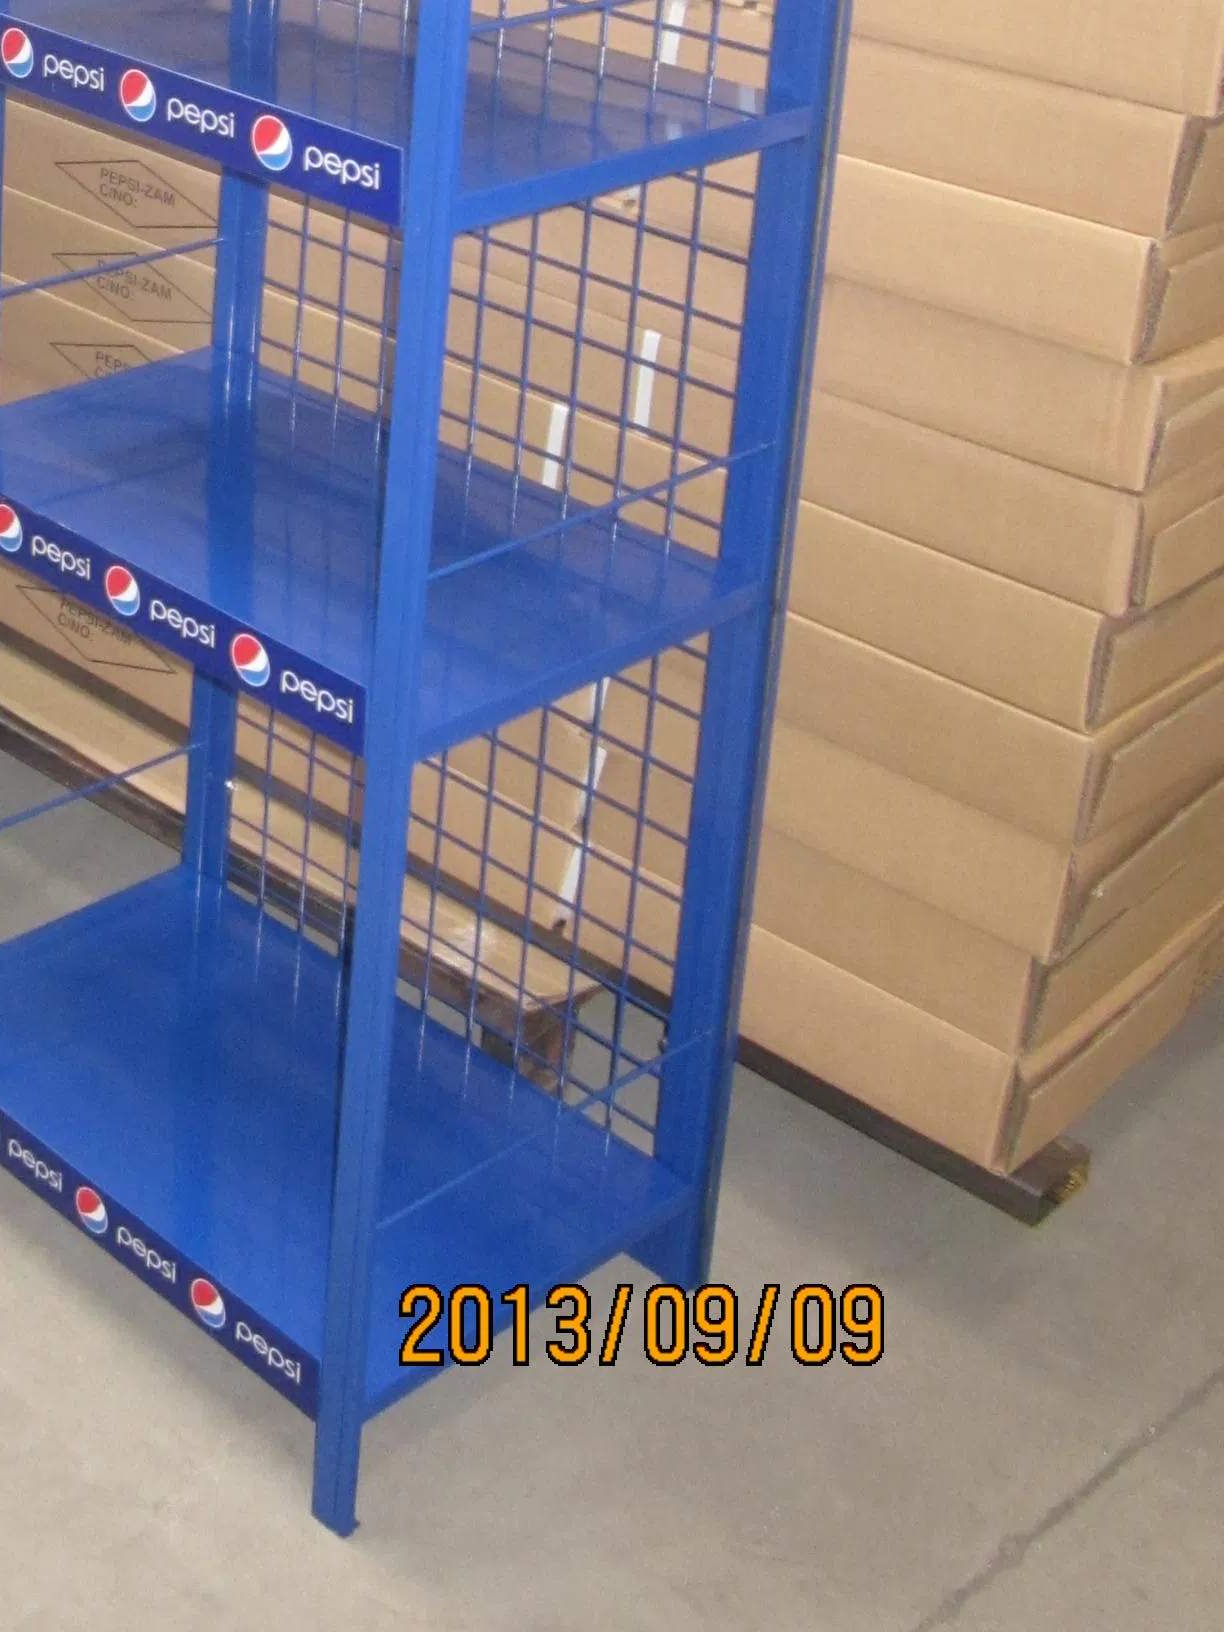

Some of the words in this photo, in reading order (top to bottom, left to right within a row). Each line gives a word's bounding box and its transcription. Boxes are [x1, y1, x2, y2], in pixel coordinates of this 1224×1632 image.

[43, 52, 105, 92] pepsi
[166, 97, 235, 139] pepsi
[303, 144, 380, 191] pepsi
[99, 167, 176, 207] PEPSI-ZAM
[30, 534, 91, 583] pepsi
[149, 598, 216, 649] pepsi
[280, 669, 354, 725] pepsi
[7, 1138, 63, 1193] pepsi
[116, 1224, 177, 1284] pepsi
[235, 1320, 302, 1384] pepsi
